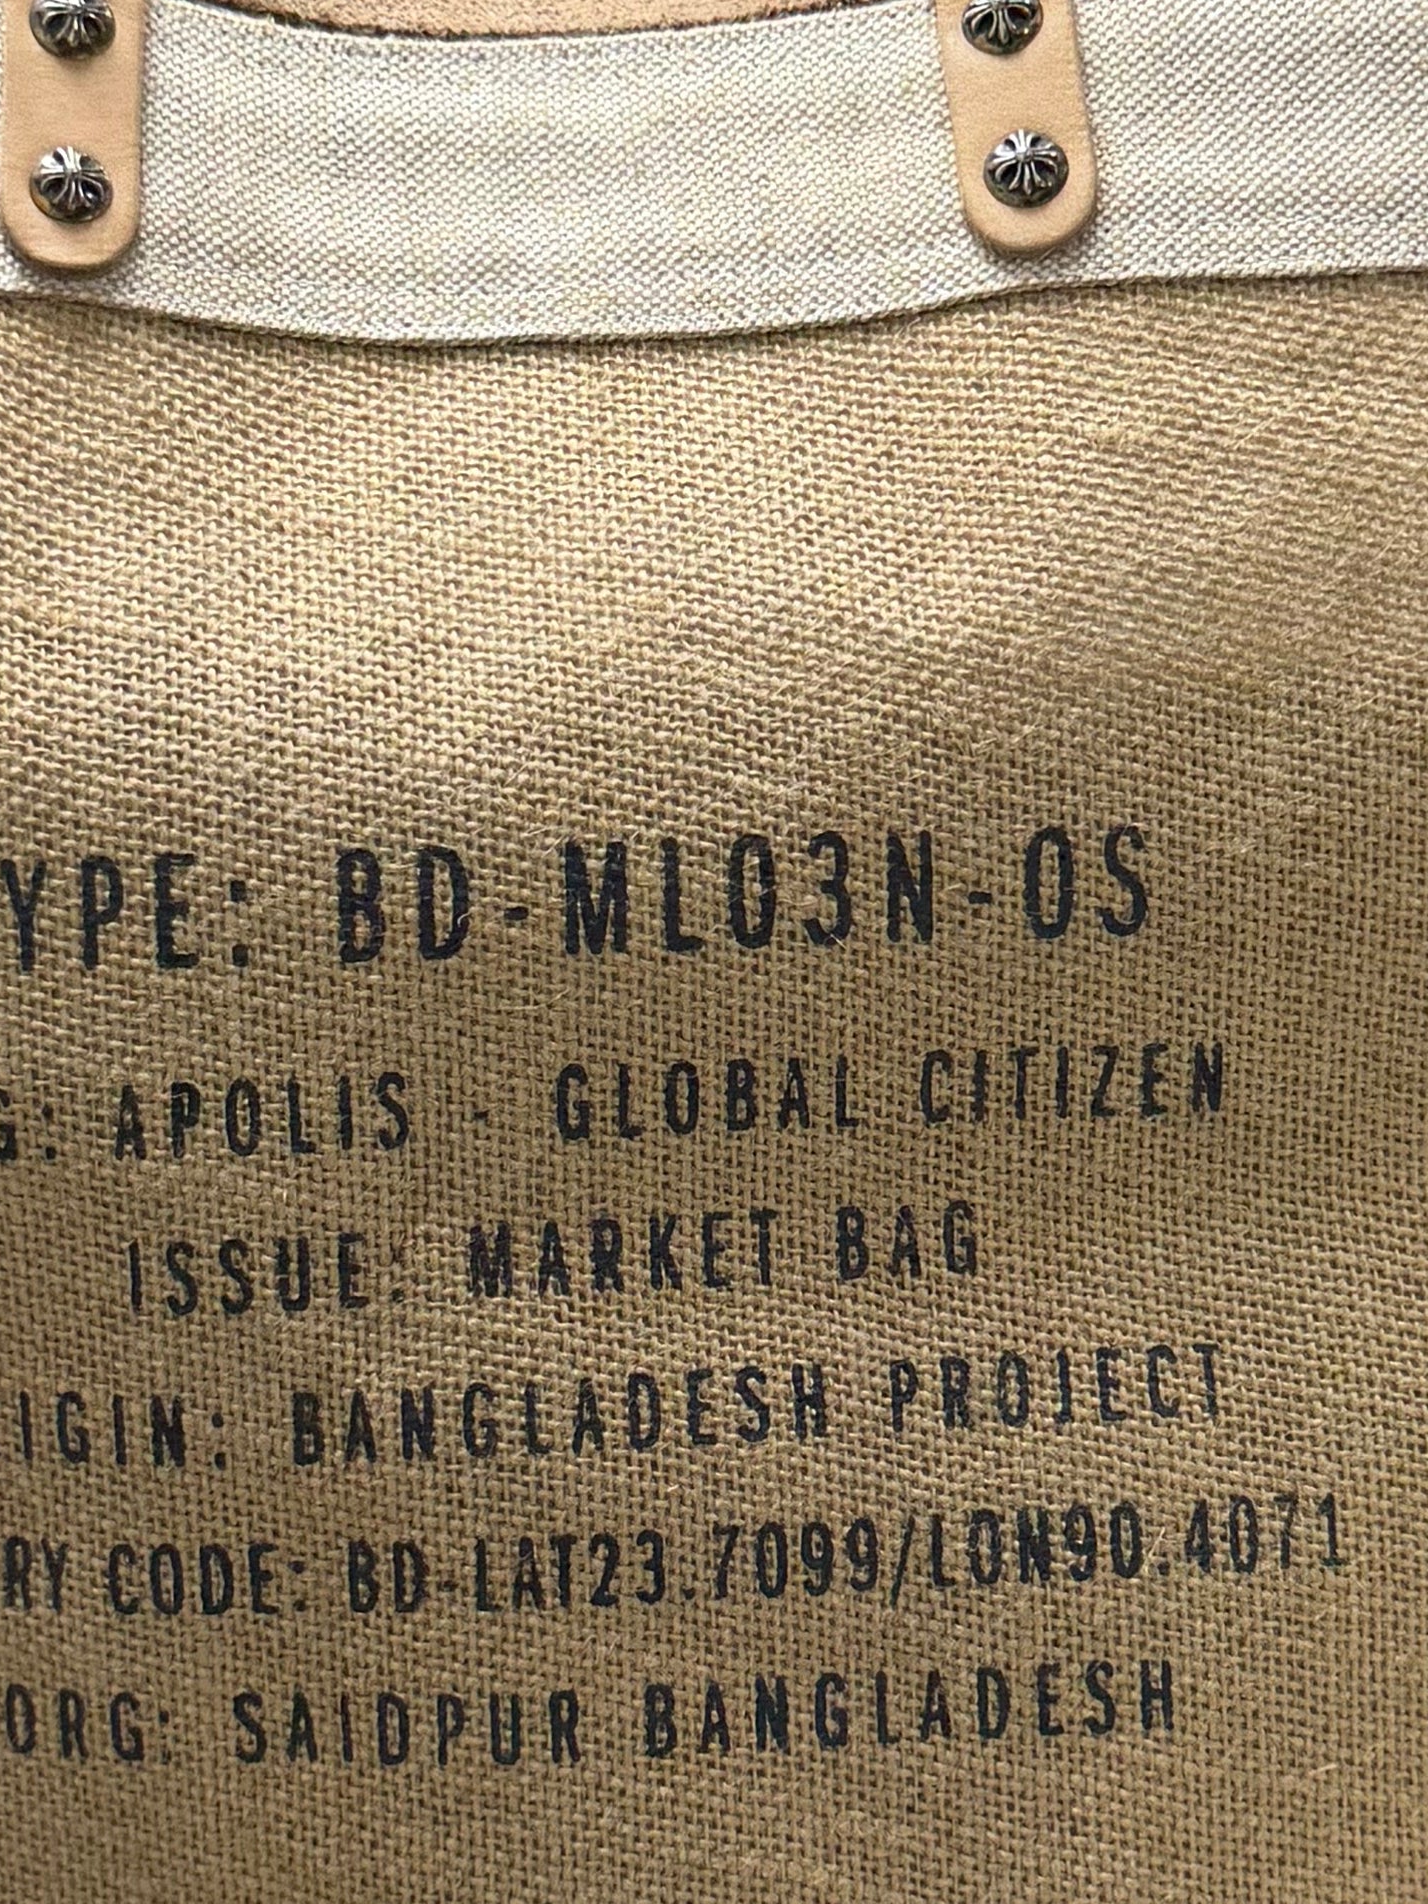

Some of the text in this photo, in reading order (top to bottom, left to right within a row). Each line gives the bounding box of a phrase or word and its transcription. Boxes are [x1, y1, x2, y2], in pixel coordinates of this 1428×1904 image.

[114, 1072, 411, 1161] APOLIS
[553, 1059, 860, 1142] GLOBAL
[920, 1044, 1225, 1125] CITIZEN
[129, 1200, 978, 1317] ISSUE: MARKET BAG
[291, 1363, 828, 1467] BANGLADESH
[889, 1343, 1220, 1433] PROJECT
[106, 1542, 307, 1616] CODE:
[3, 1660, 1174, 1767] ORG: SAIDPUR BANGLADESH
